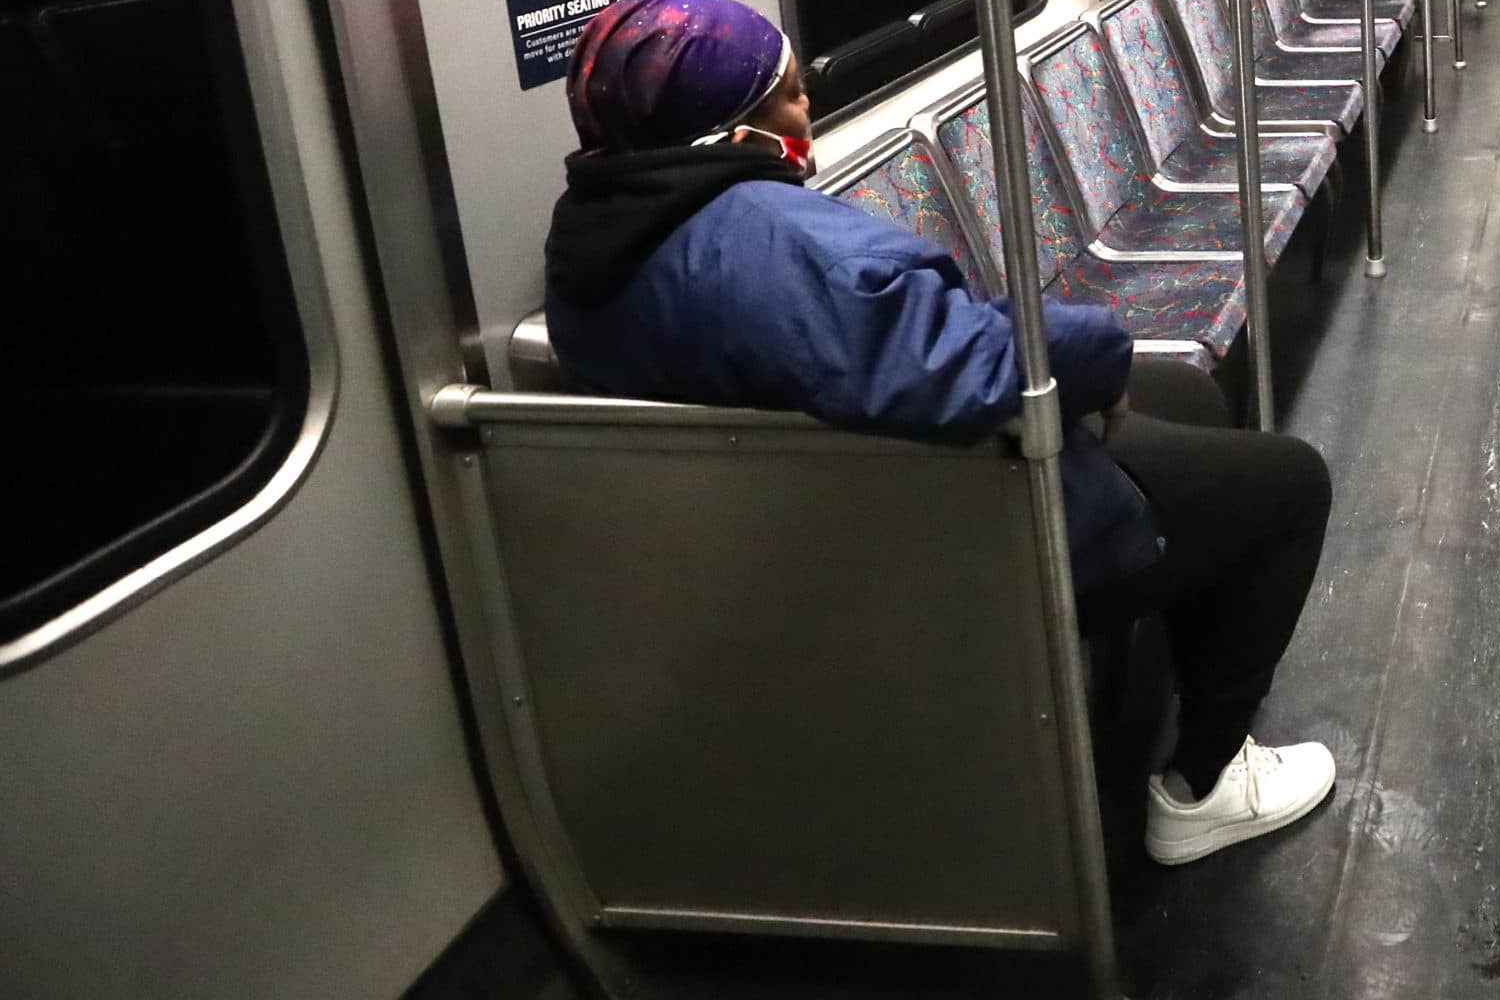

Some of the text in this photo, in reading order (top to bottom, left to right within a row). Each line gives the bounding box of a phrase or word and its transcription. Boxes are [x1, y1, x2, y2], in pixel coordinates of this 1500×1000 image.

[517, 0, 566, 31] PRIORITY
[523, 37, 579, 60] move for senior
[526, 31, 564, 48] Customers
[565, 28, 577, 37] are
[547, 53, 563, 63] with
